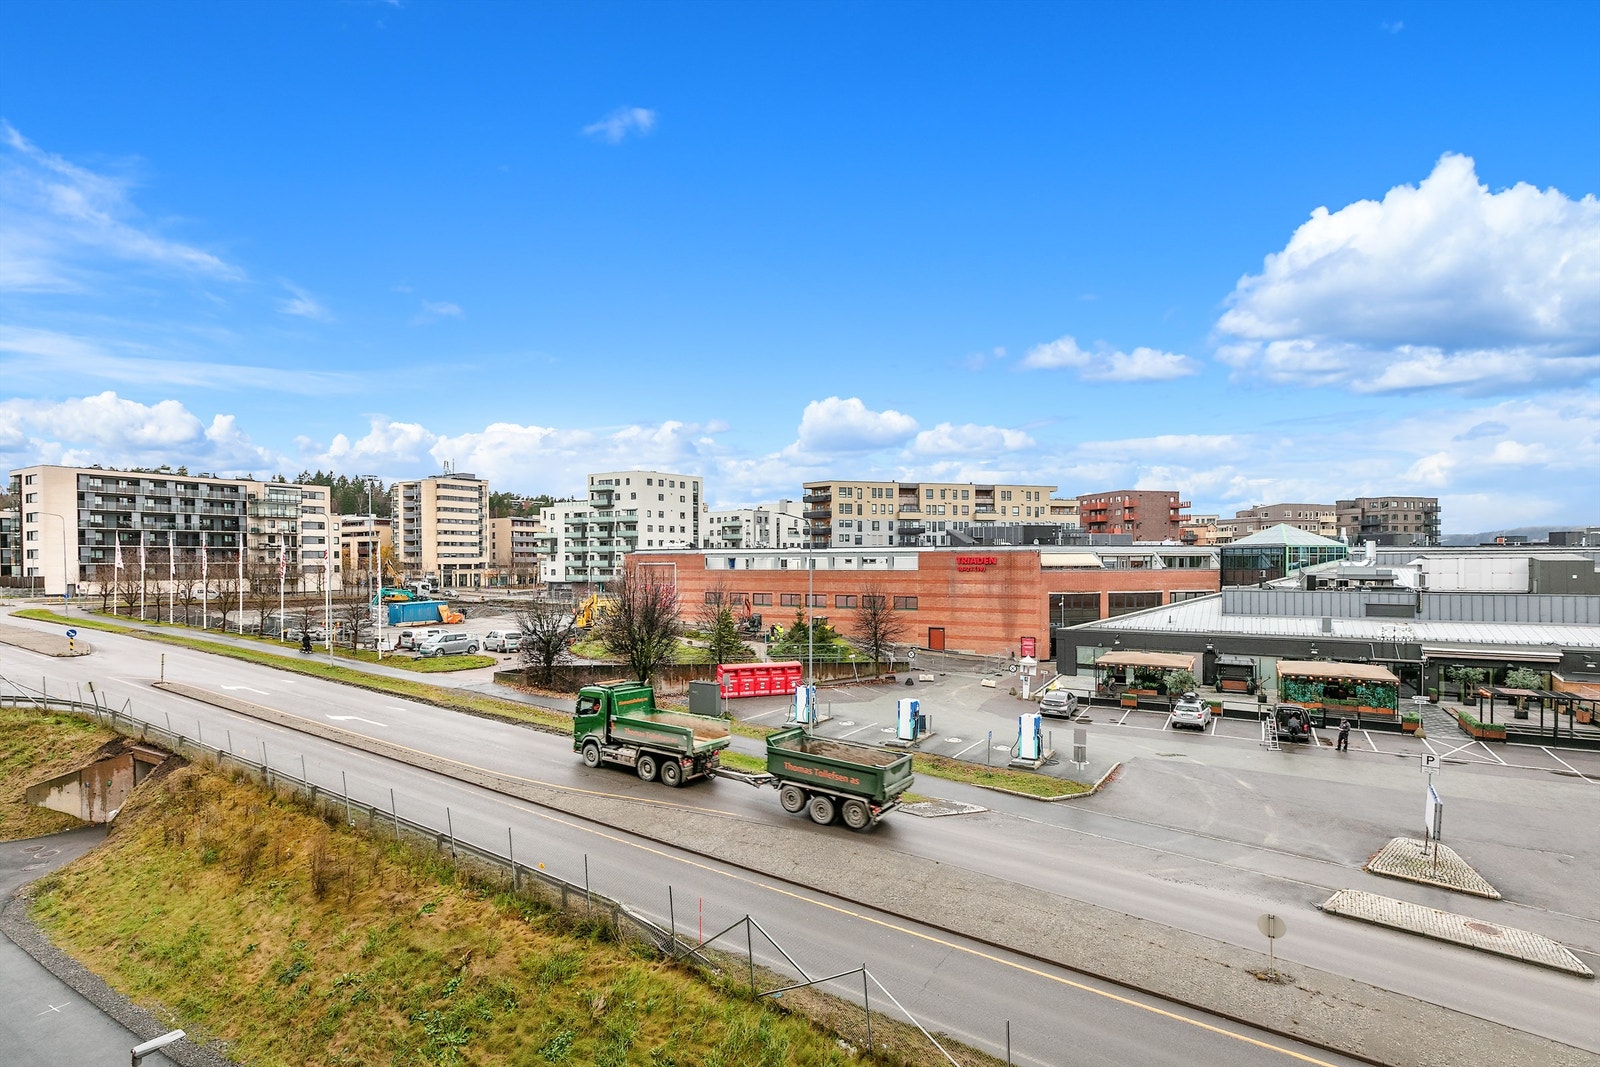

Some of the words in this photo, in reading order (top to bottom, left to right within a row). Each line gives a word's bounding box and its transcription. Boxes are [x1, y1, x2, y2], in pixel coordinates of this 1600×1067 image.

[956, 556, 997, 565] TRIADEN
[1426, 755, 1435, 765] P
[784, 761, 812, 775] Thomas
[814, 768, 849, 783] Tollefsen
[849, 777, 860, 786] as
